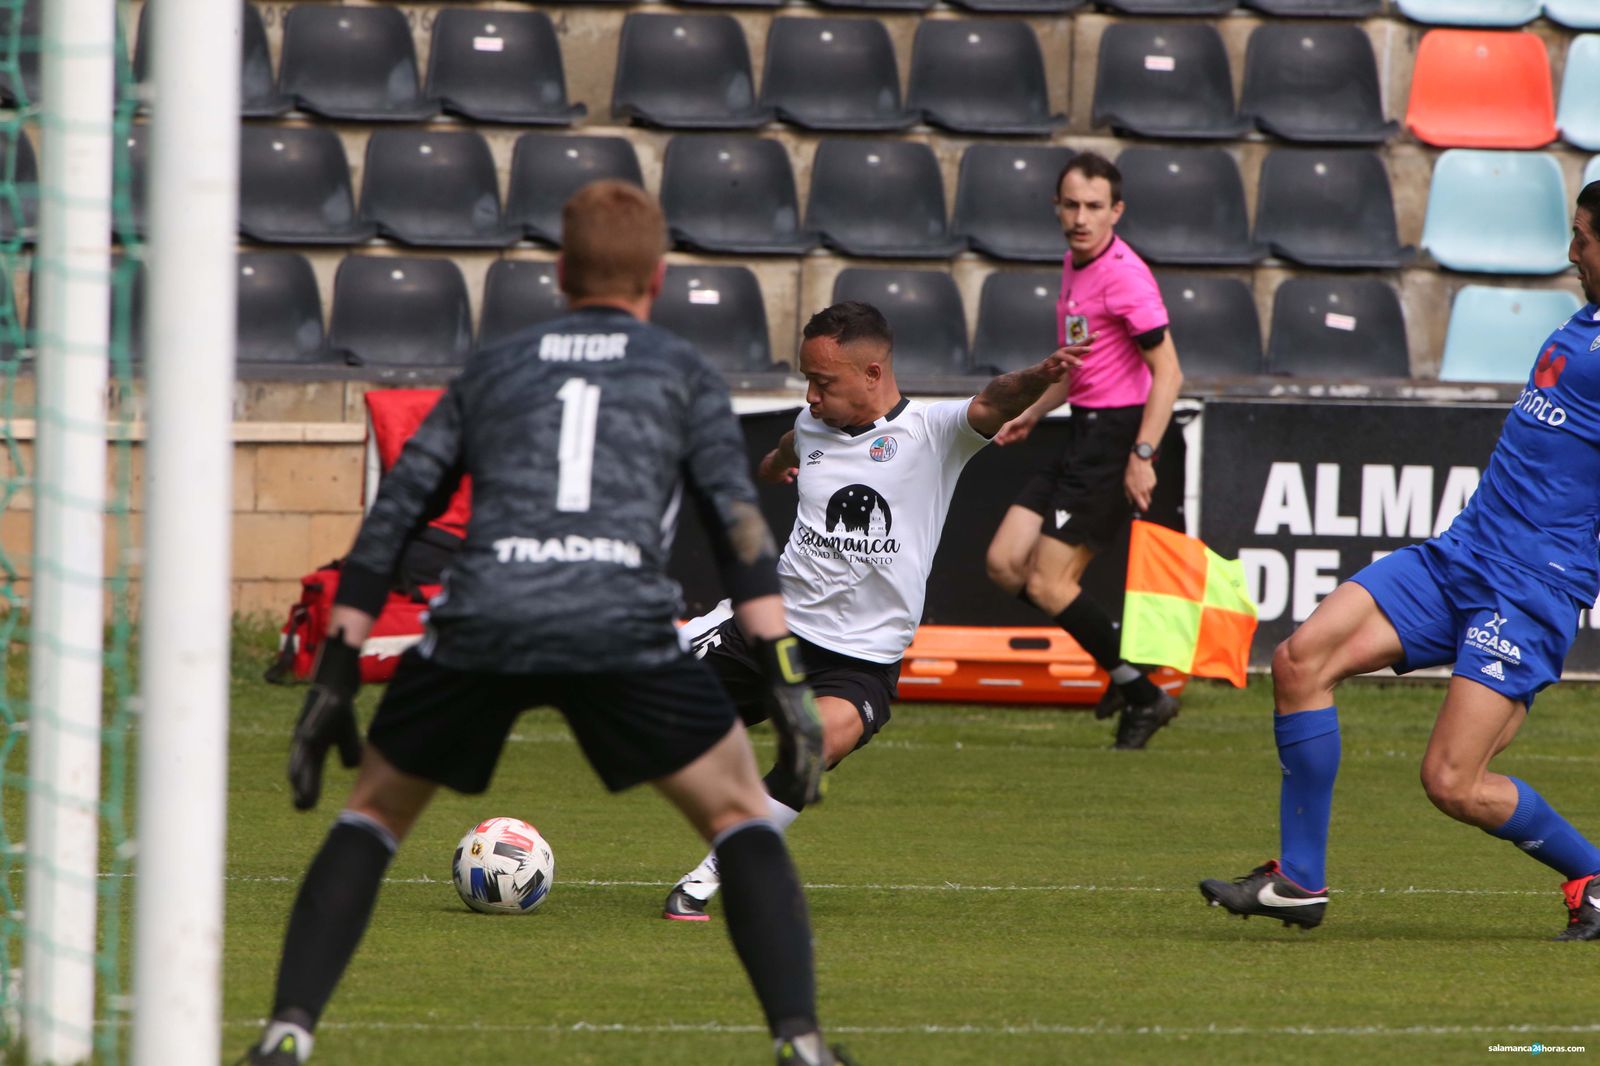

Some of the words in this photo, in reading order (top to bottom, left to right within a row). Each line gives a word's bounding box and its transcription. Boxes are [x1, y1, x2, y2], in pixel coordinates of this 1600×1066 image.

[539, 332, 629, 361] AITOR
[556, 378, 601, 512] 1
[797, 526, 901, 555] Salamanca
[1238, 548, 1341, 622] DE
[1481, 667, 1505, 681] adidas
